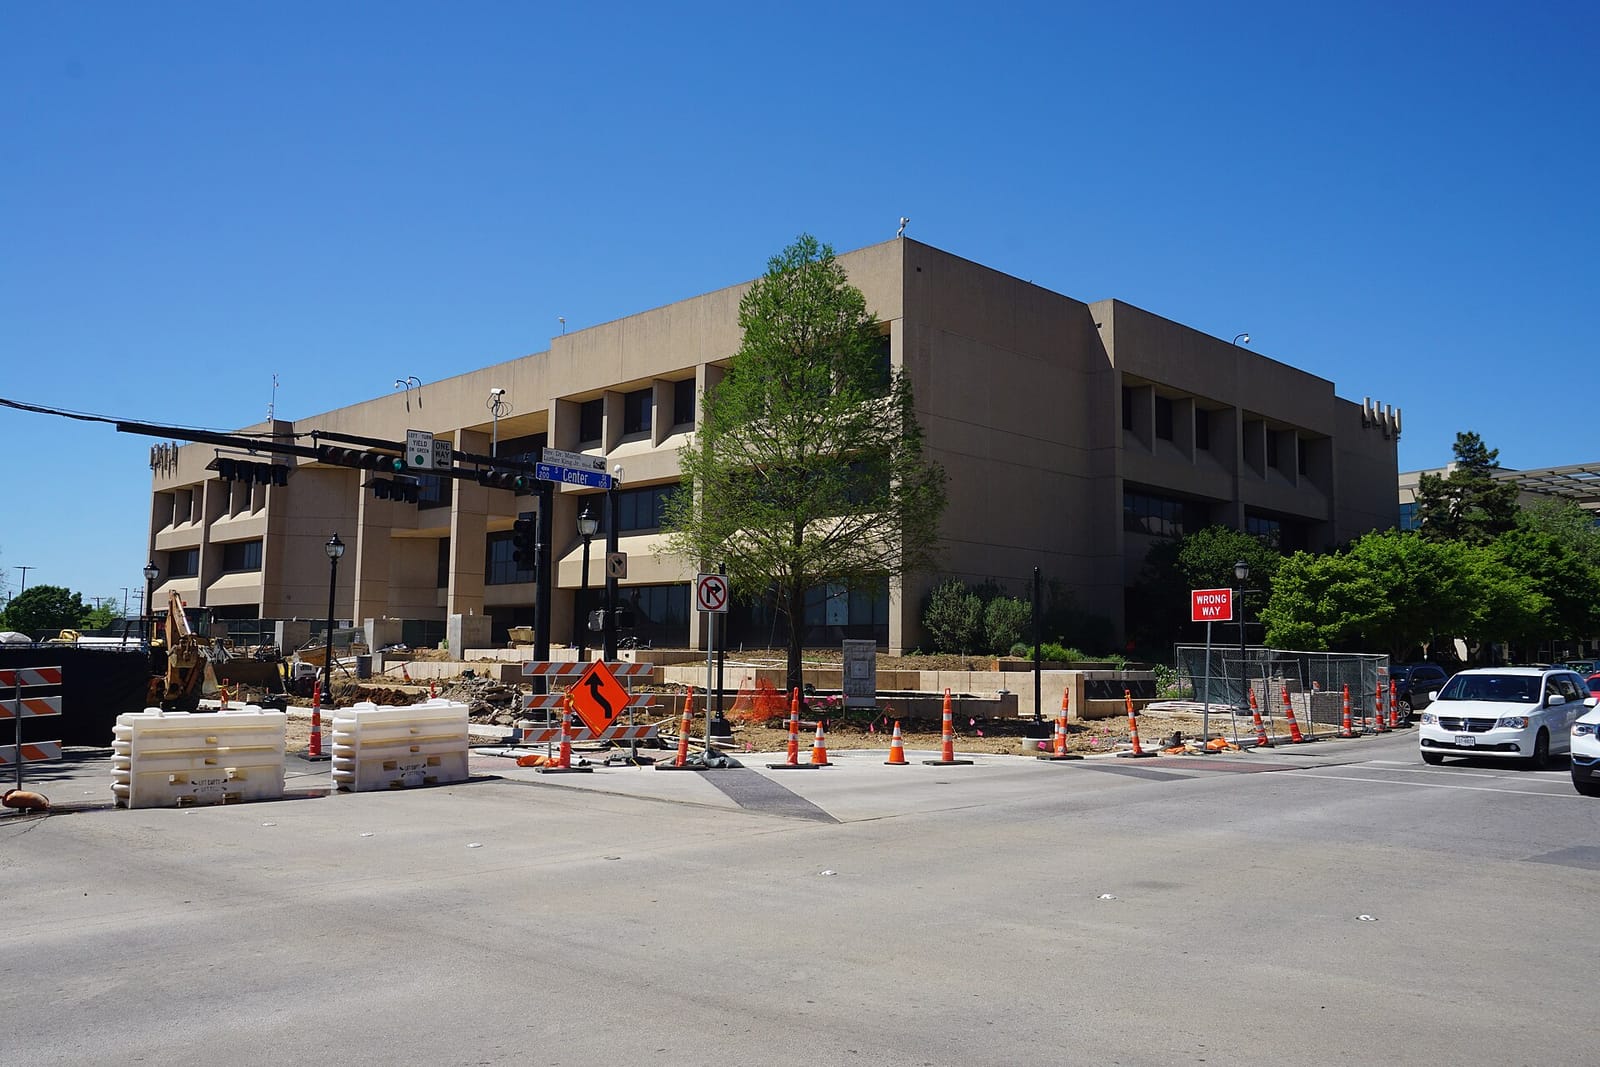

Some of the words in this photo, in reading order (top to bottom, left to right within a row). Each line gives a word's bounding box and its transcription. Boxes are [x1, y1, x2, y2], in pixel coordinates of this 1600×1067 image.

[436, 442, 450, 450] ONE
[564, 452, 581, 460] Martin
[539, 471, 550, 479] 200
[562, 468, 589, 485] Center
[1196, 594, 1226, 604] WRONG
[1202, 606, 1221, 616] WAY
